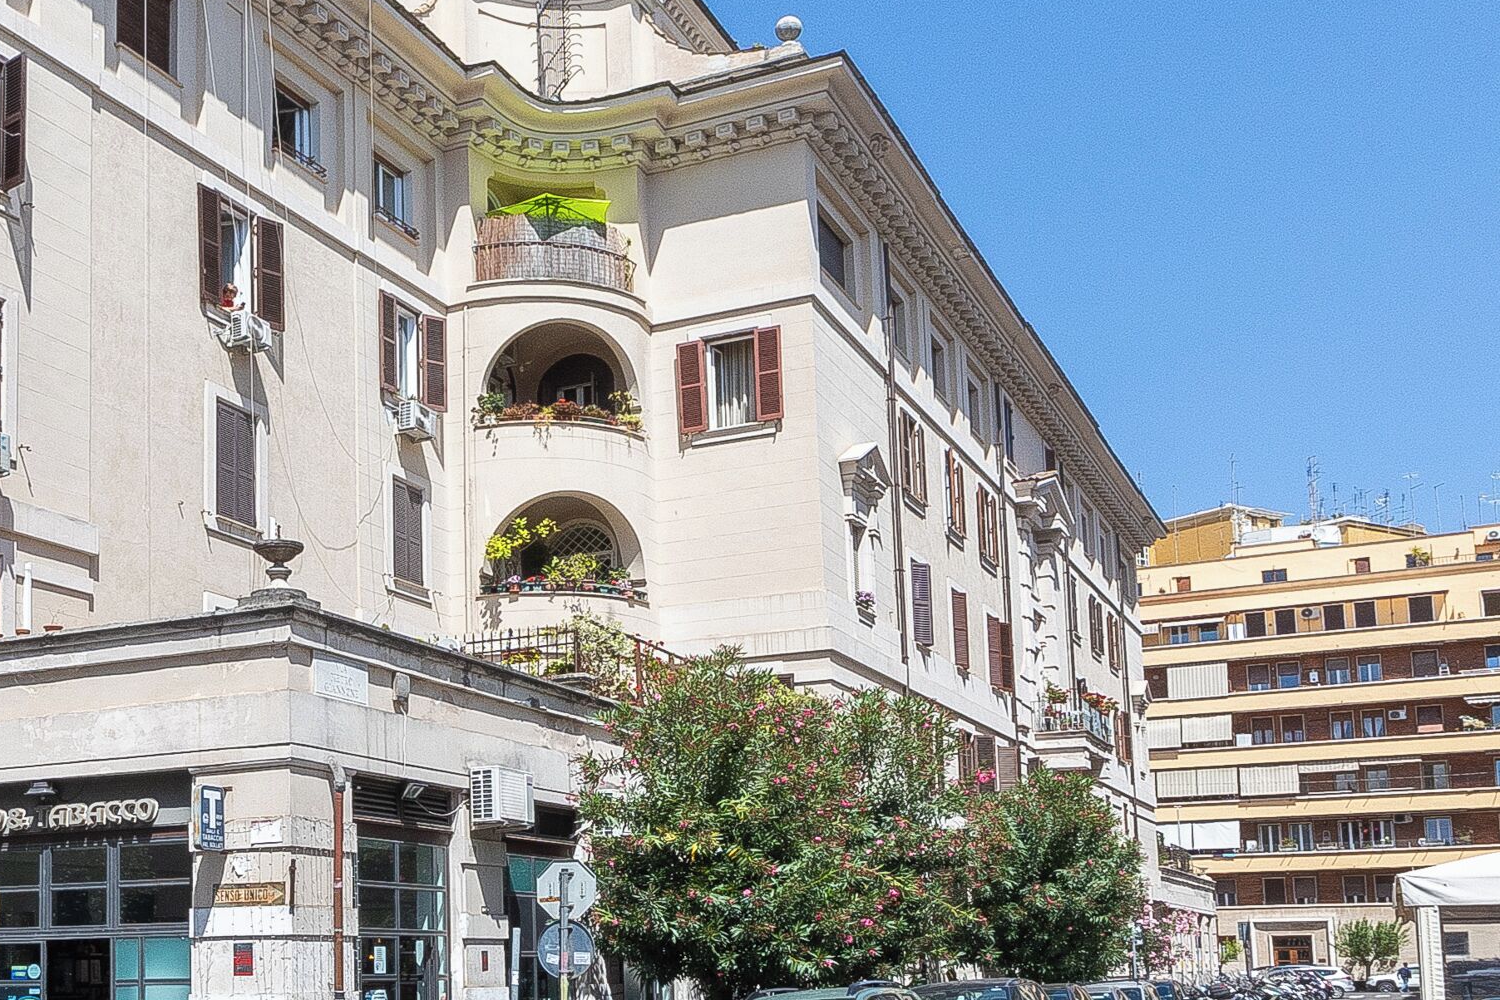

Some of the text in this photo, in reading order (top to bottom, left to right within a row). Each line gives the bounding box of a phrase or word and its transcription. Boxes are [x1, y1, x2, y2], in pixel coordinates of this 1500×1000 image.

[8, 807, 34, 831] &
[34, 798, 159, 831] TABACCO
[203, 789, 222, 829] T
[215, 888, 269, 902] SENSO UNICO
